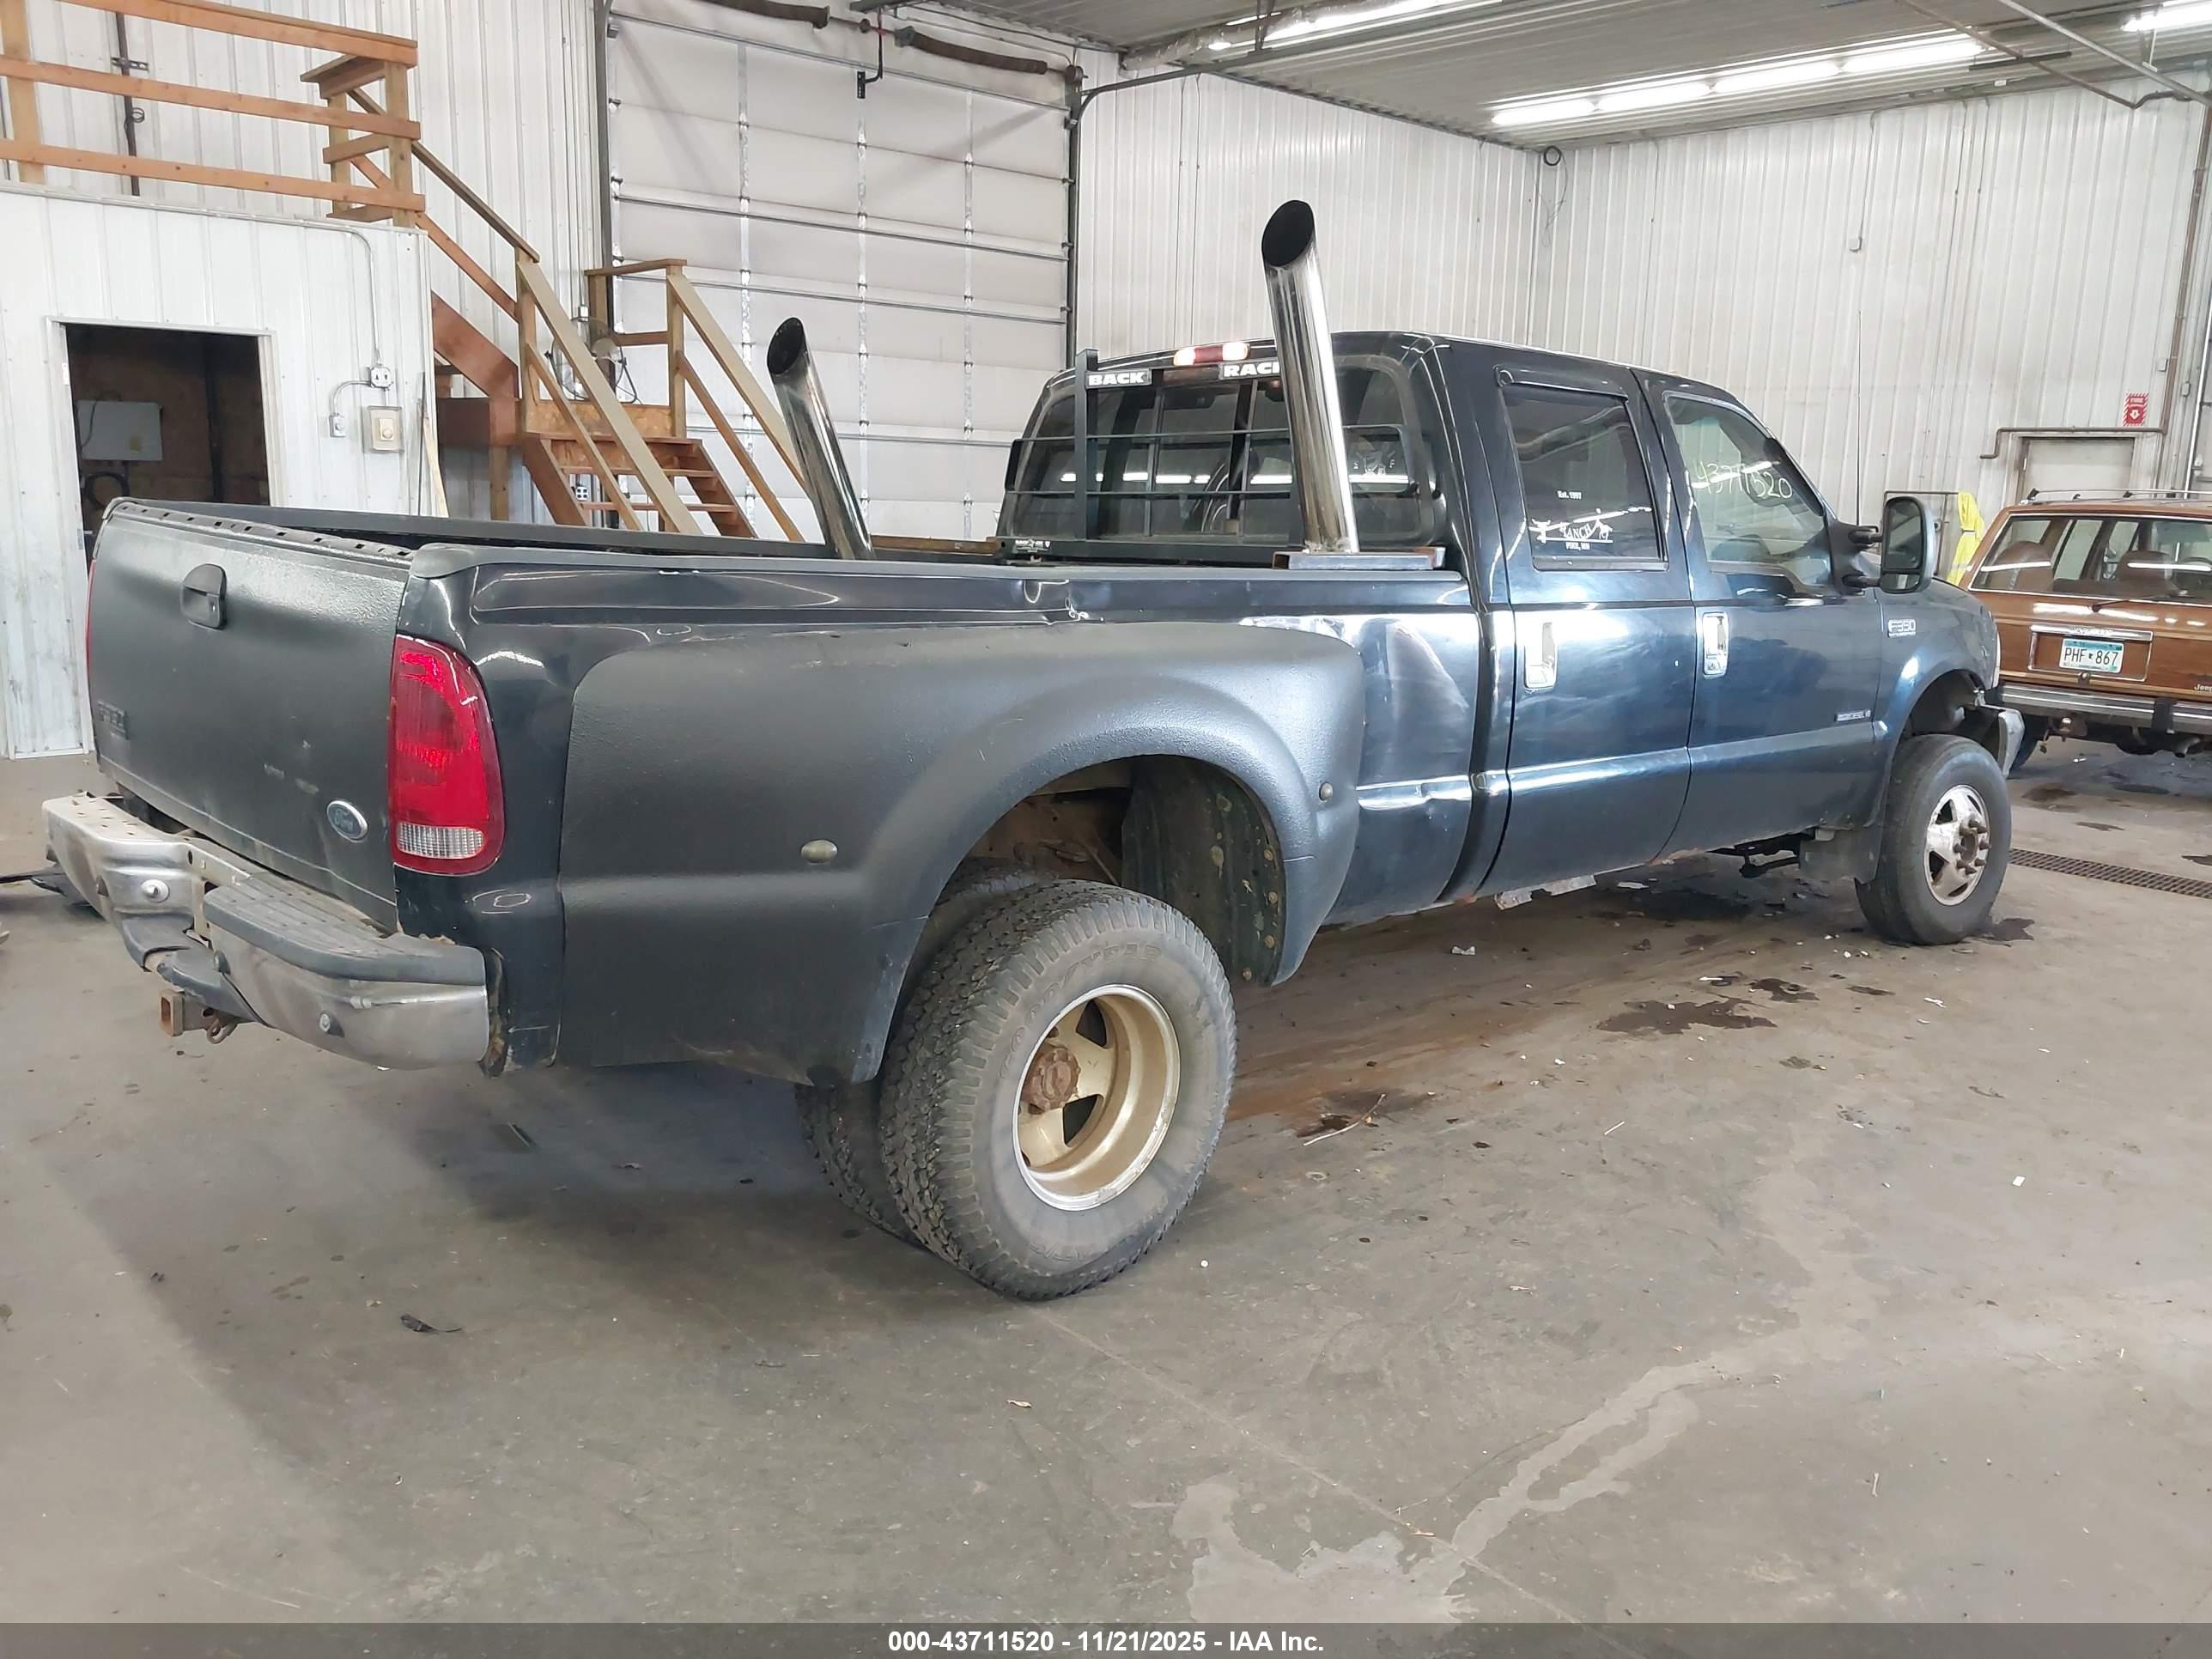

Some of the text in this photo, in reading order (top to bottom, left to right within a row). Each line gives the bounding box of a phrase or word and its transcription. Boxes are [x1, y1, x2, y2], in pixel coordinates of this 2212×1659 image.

[1088, 372, 1146, 386] BACK
[2063, 647, 2087, 663] PHF
[2095, 649, 2119, 666] 867
